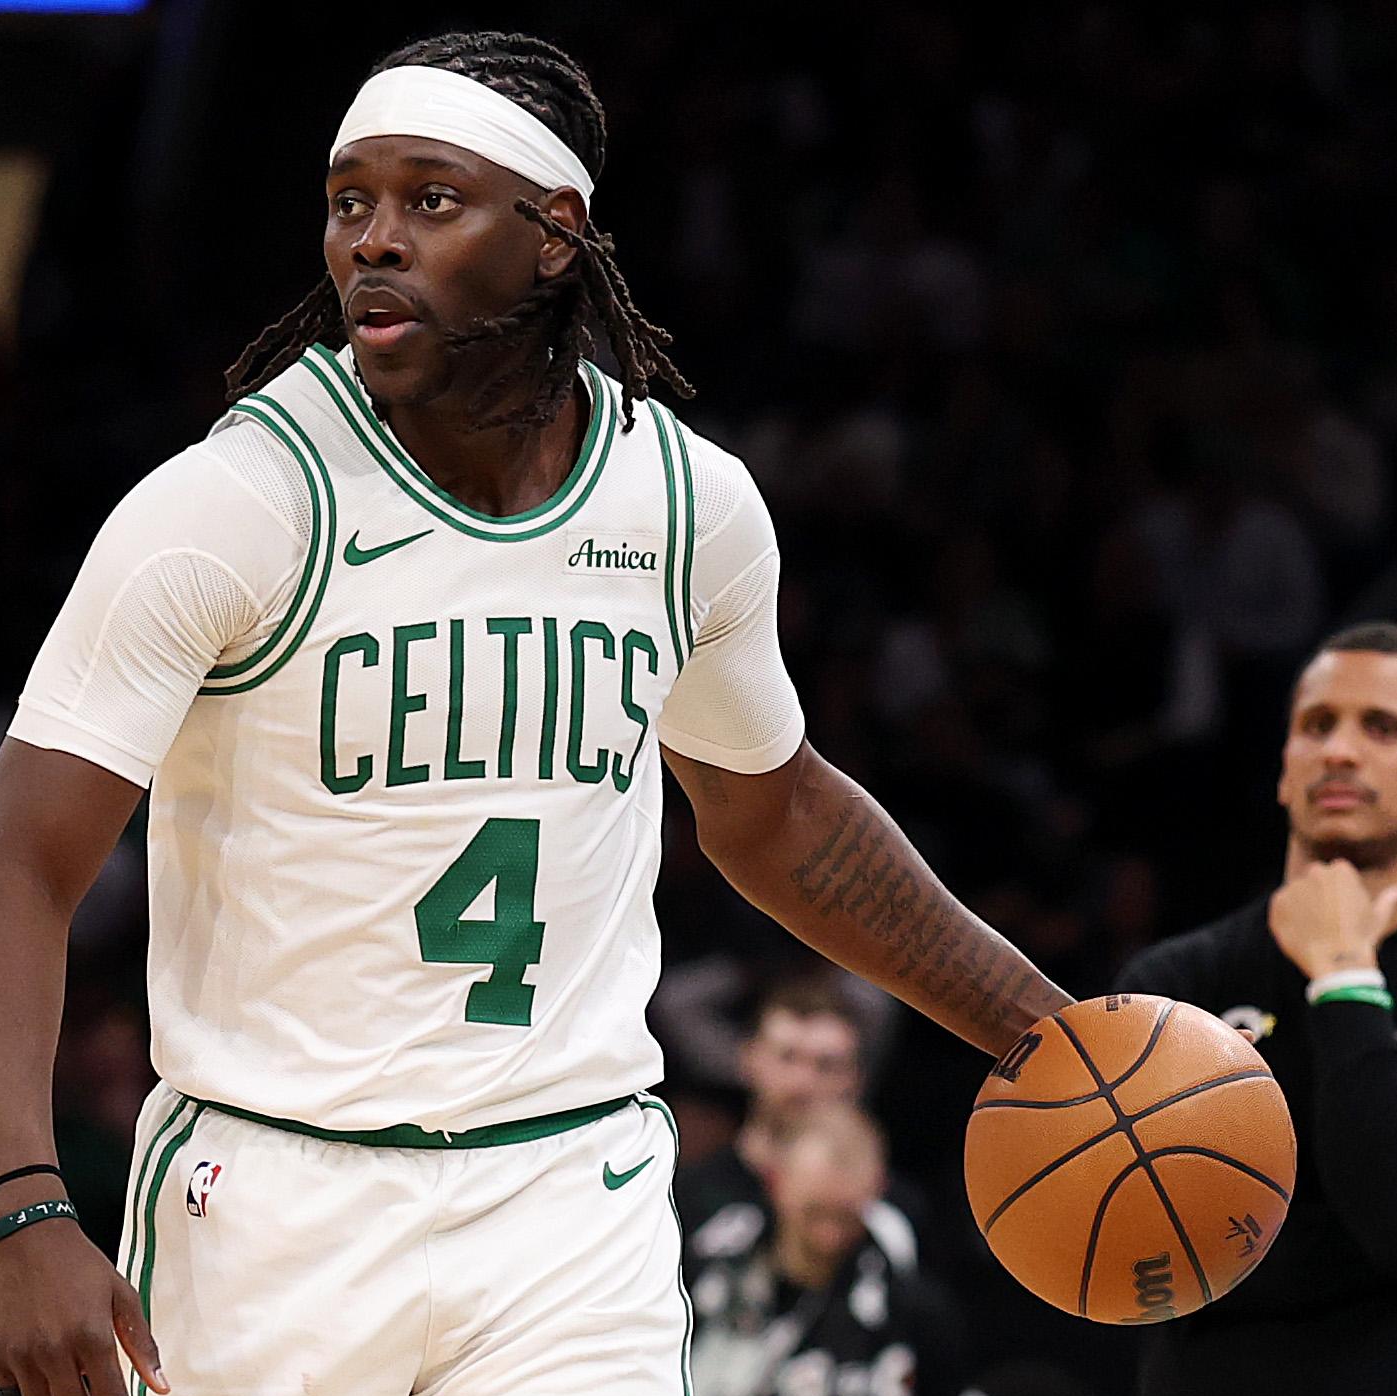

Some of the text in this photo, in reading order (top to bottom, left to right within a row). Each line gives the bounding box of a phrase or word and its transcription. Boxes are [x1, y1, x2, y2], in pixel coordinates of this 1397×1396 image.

[567, 538, 658, 572] Amica
[319, 617, 659, 796] CELTICS
[413, 818, 547, 1027] 4
